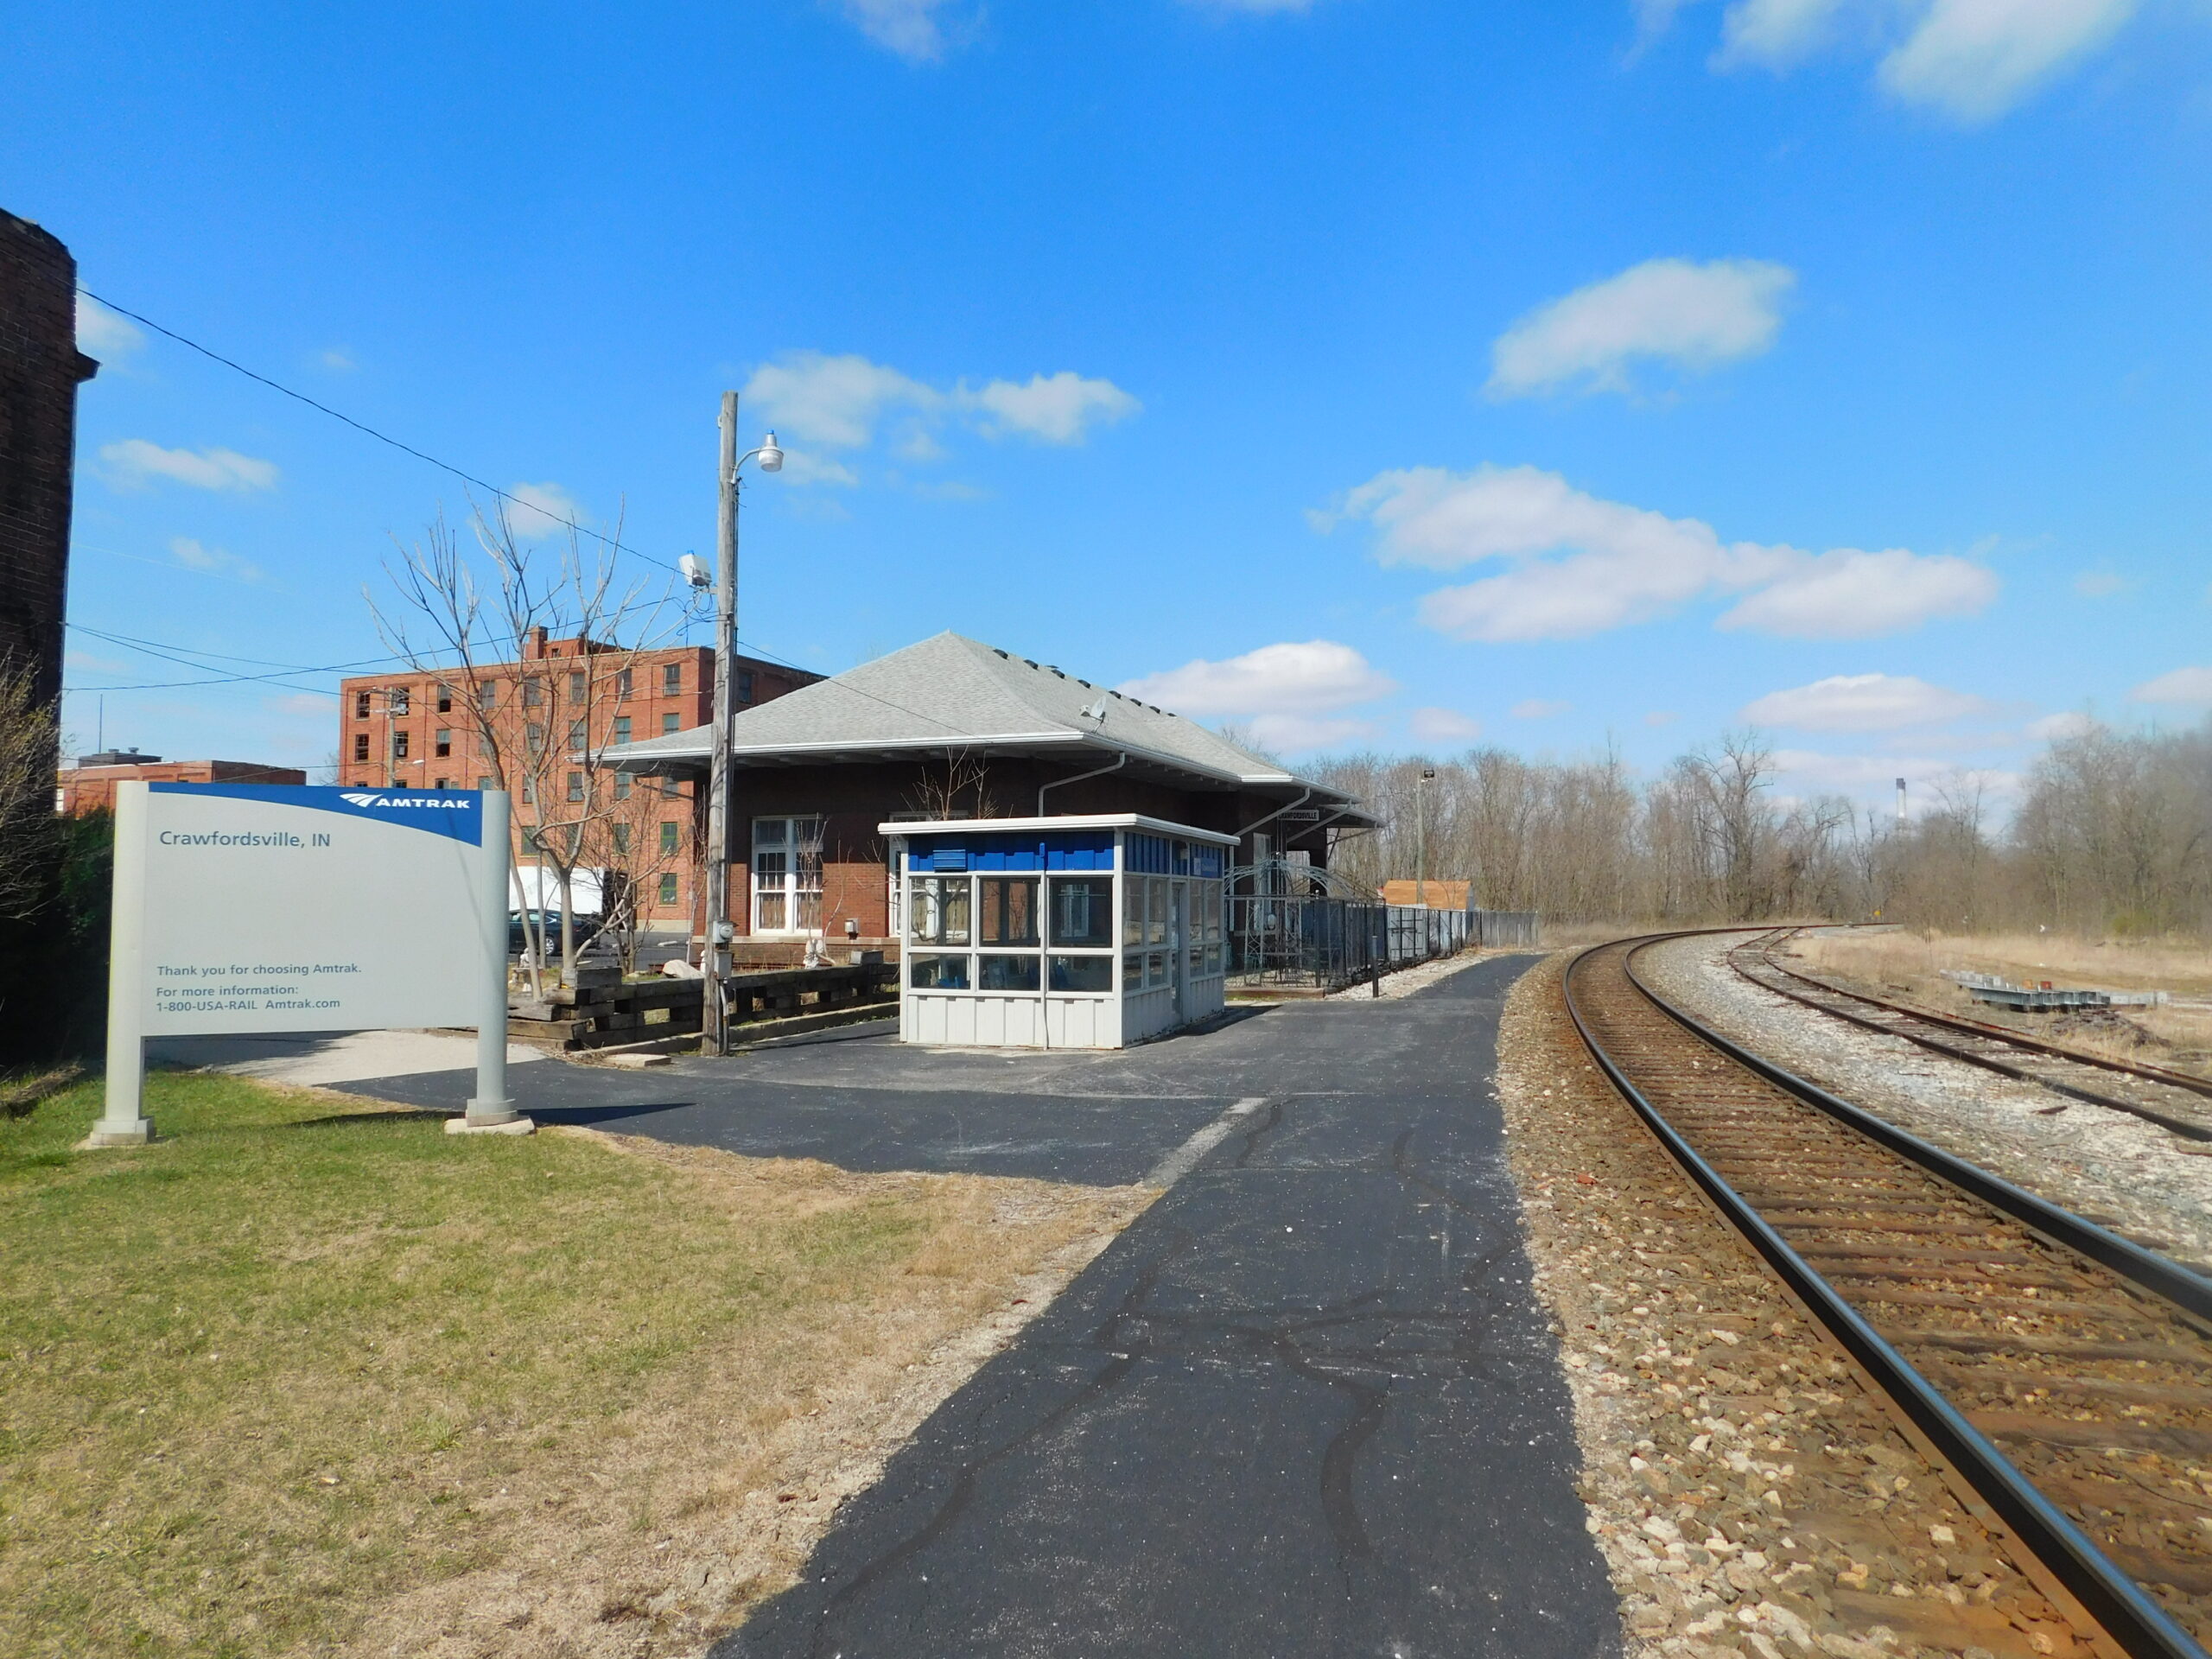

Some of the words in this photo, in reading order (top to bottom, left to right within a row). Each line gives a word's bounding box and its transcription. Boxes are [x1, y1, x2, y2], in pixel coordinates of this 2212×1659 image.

[375, 798, 471, 809] AMTRAK
[159, 830, 305, 849] Crawfordsville,
[312, 833, 331, 847] IN
[157, 965, 198, 976] Thank
[201, 967, 226, 977] you
[230, 964, 250, 975] for
[252, 963, 309, 976] choosing
[313, 963, 362, 974] Amtrak.
[156, 987, 178, 997] For
[181, 988, 215, 996] more
[219, 984, 299, 996] information:
[156, 1000, 257, 1012] 1-800-USA-RAIL
[264, 998, 340, 1009] Amtrak.com
